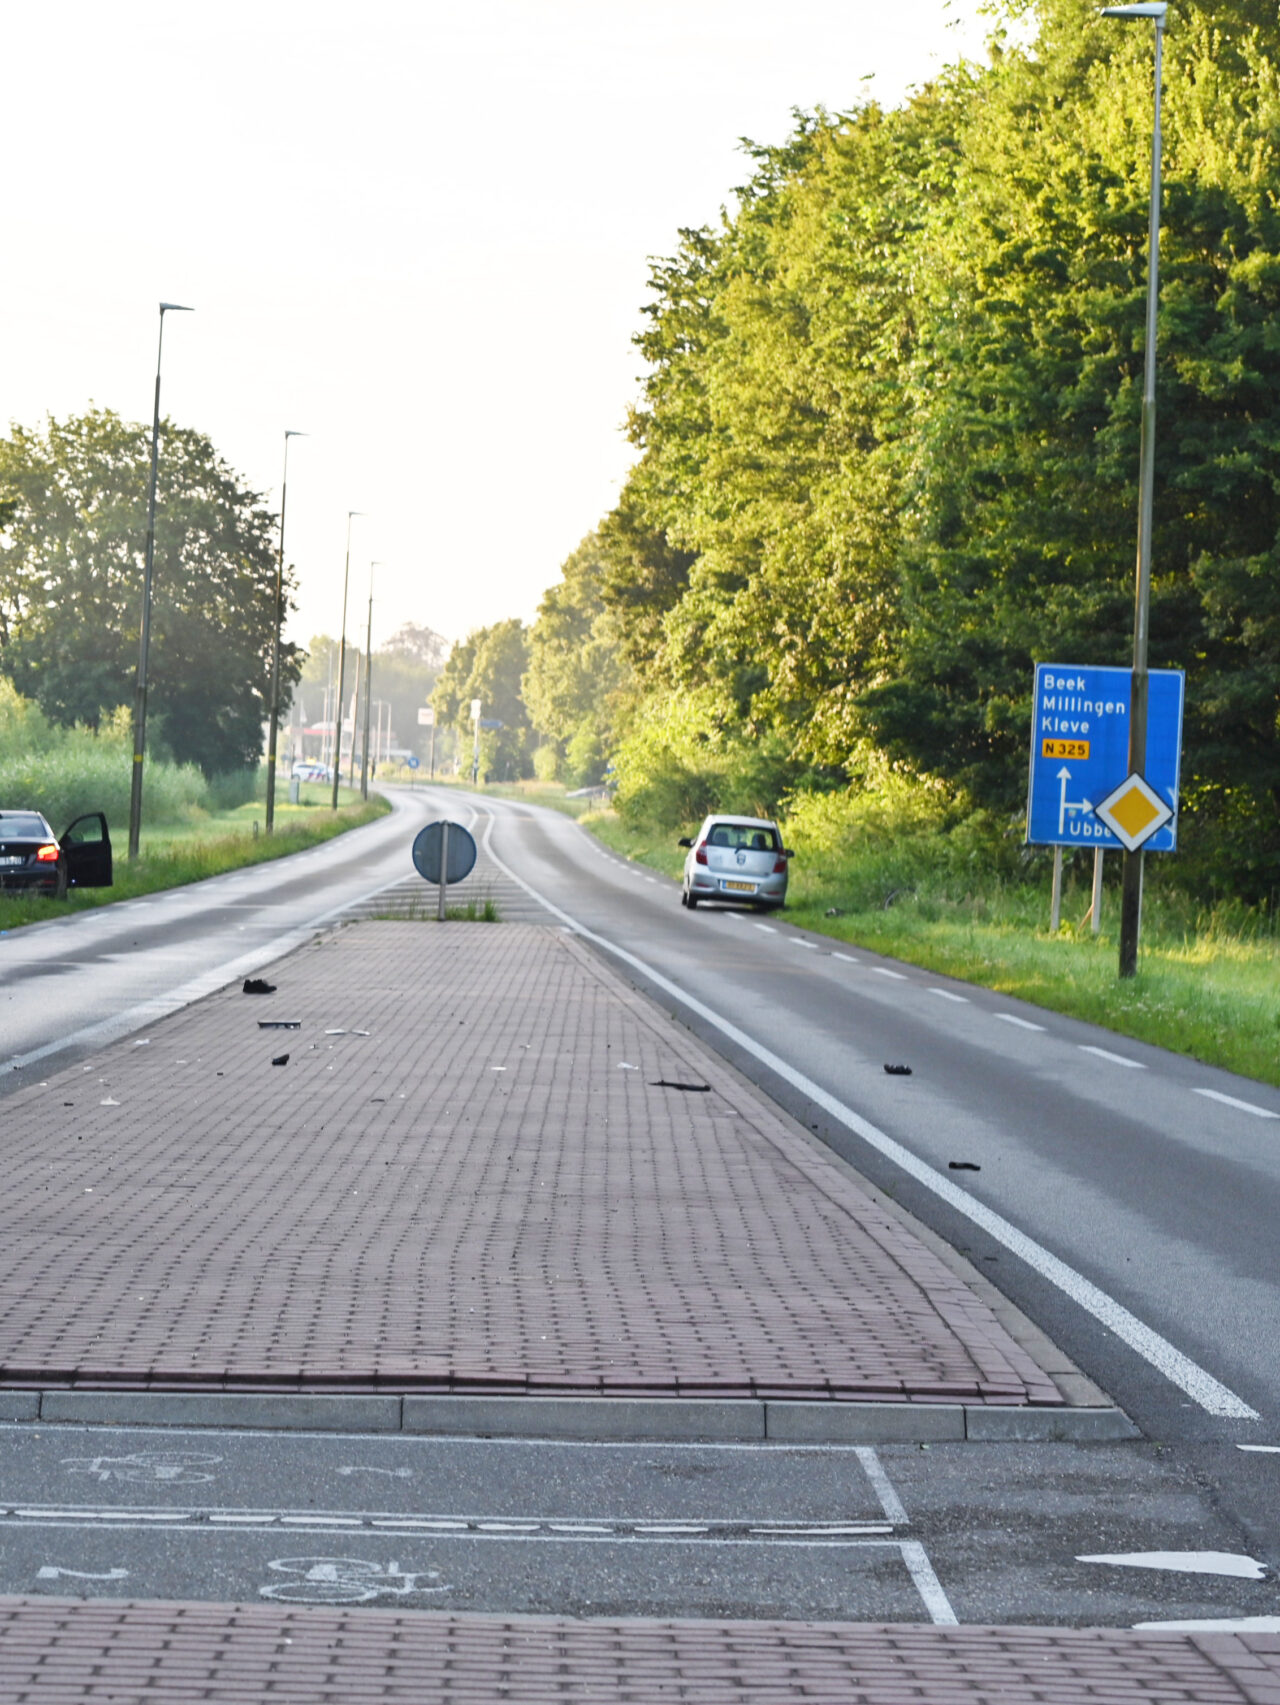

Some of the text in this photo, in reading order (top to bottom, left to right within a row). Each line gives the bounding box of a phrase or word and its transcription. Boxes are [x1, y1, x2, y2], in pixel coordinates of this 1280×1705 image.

[1044, 674, 1086, 691] Beek
[1043, 696, 1125, 717] Millingen
[1042, 717, 1089, 733] Kleve
[1070, 822, 1112, 837] Ubbe
